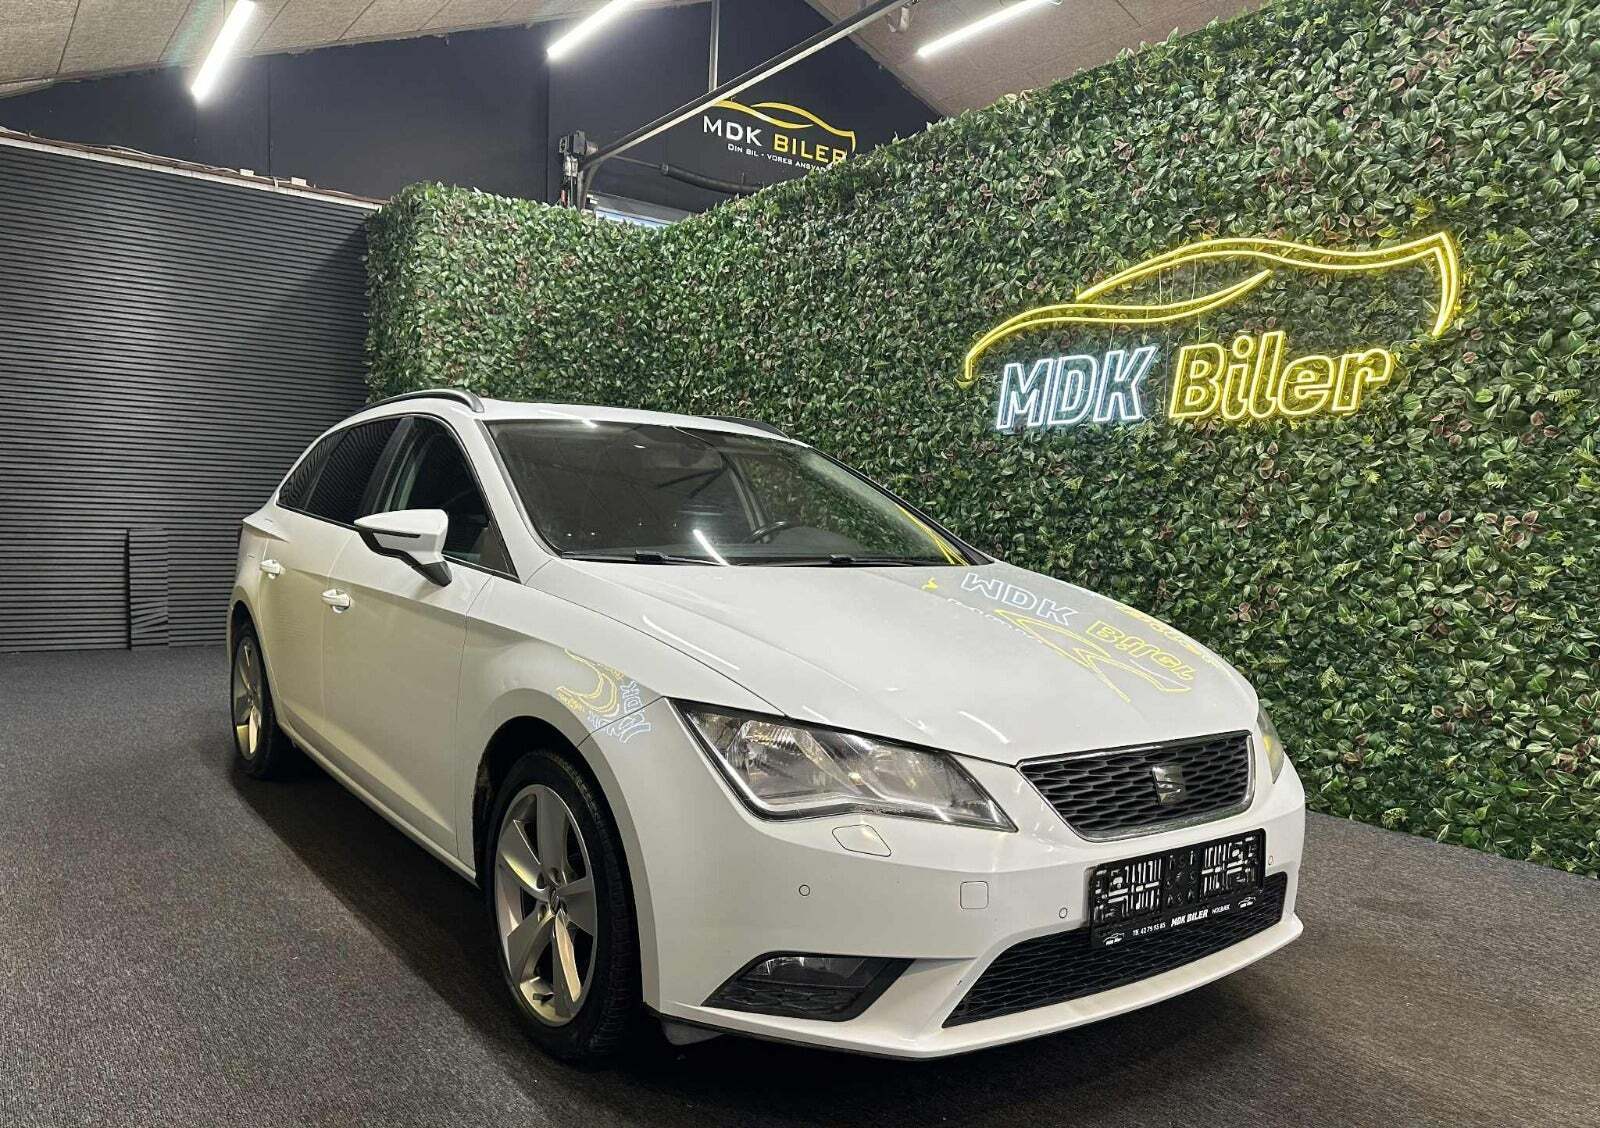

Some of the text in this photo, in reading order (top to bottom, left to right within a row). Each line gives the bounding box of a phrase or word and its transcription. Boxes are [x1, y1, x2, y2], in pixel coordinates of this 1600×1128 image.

[703, 115, 848, 163] MDK BILER
[746, 149, 759, 157] BIL
[767, 153, 793, 165] VORES
[996, 330, 1394, 431] MDK Biler
[1170, 908, 1209, 927] MDK BILER
